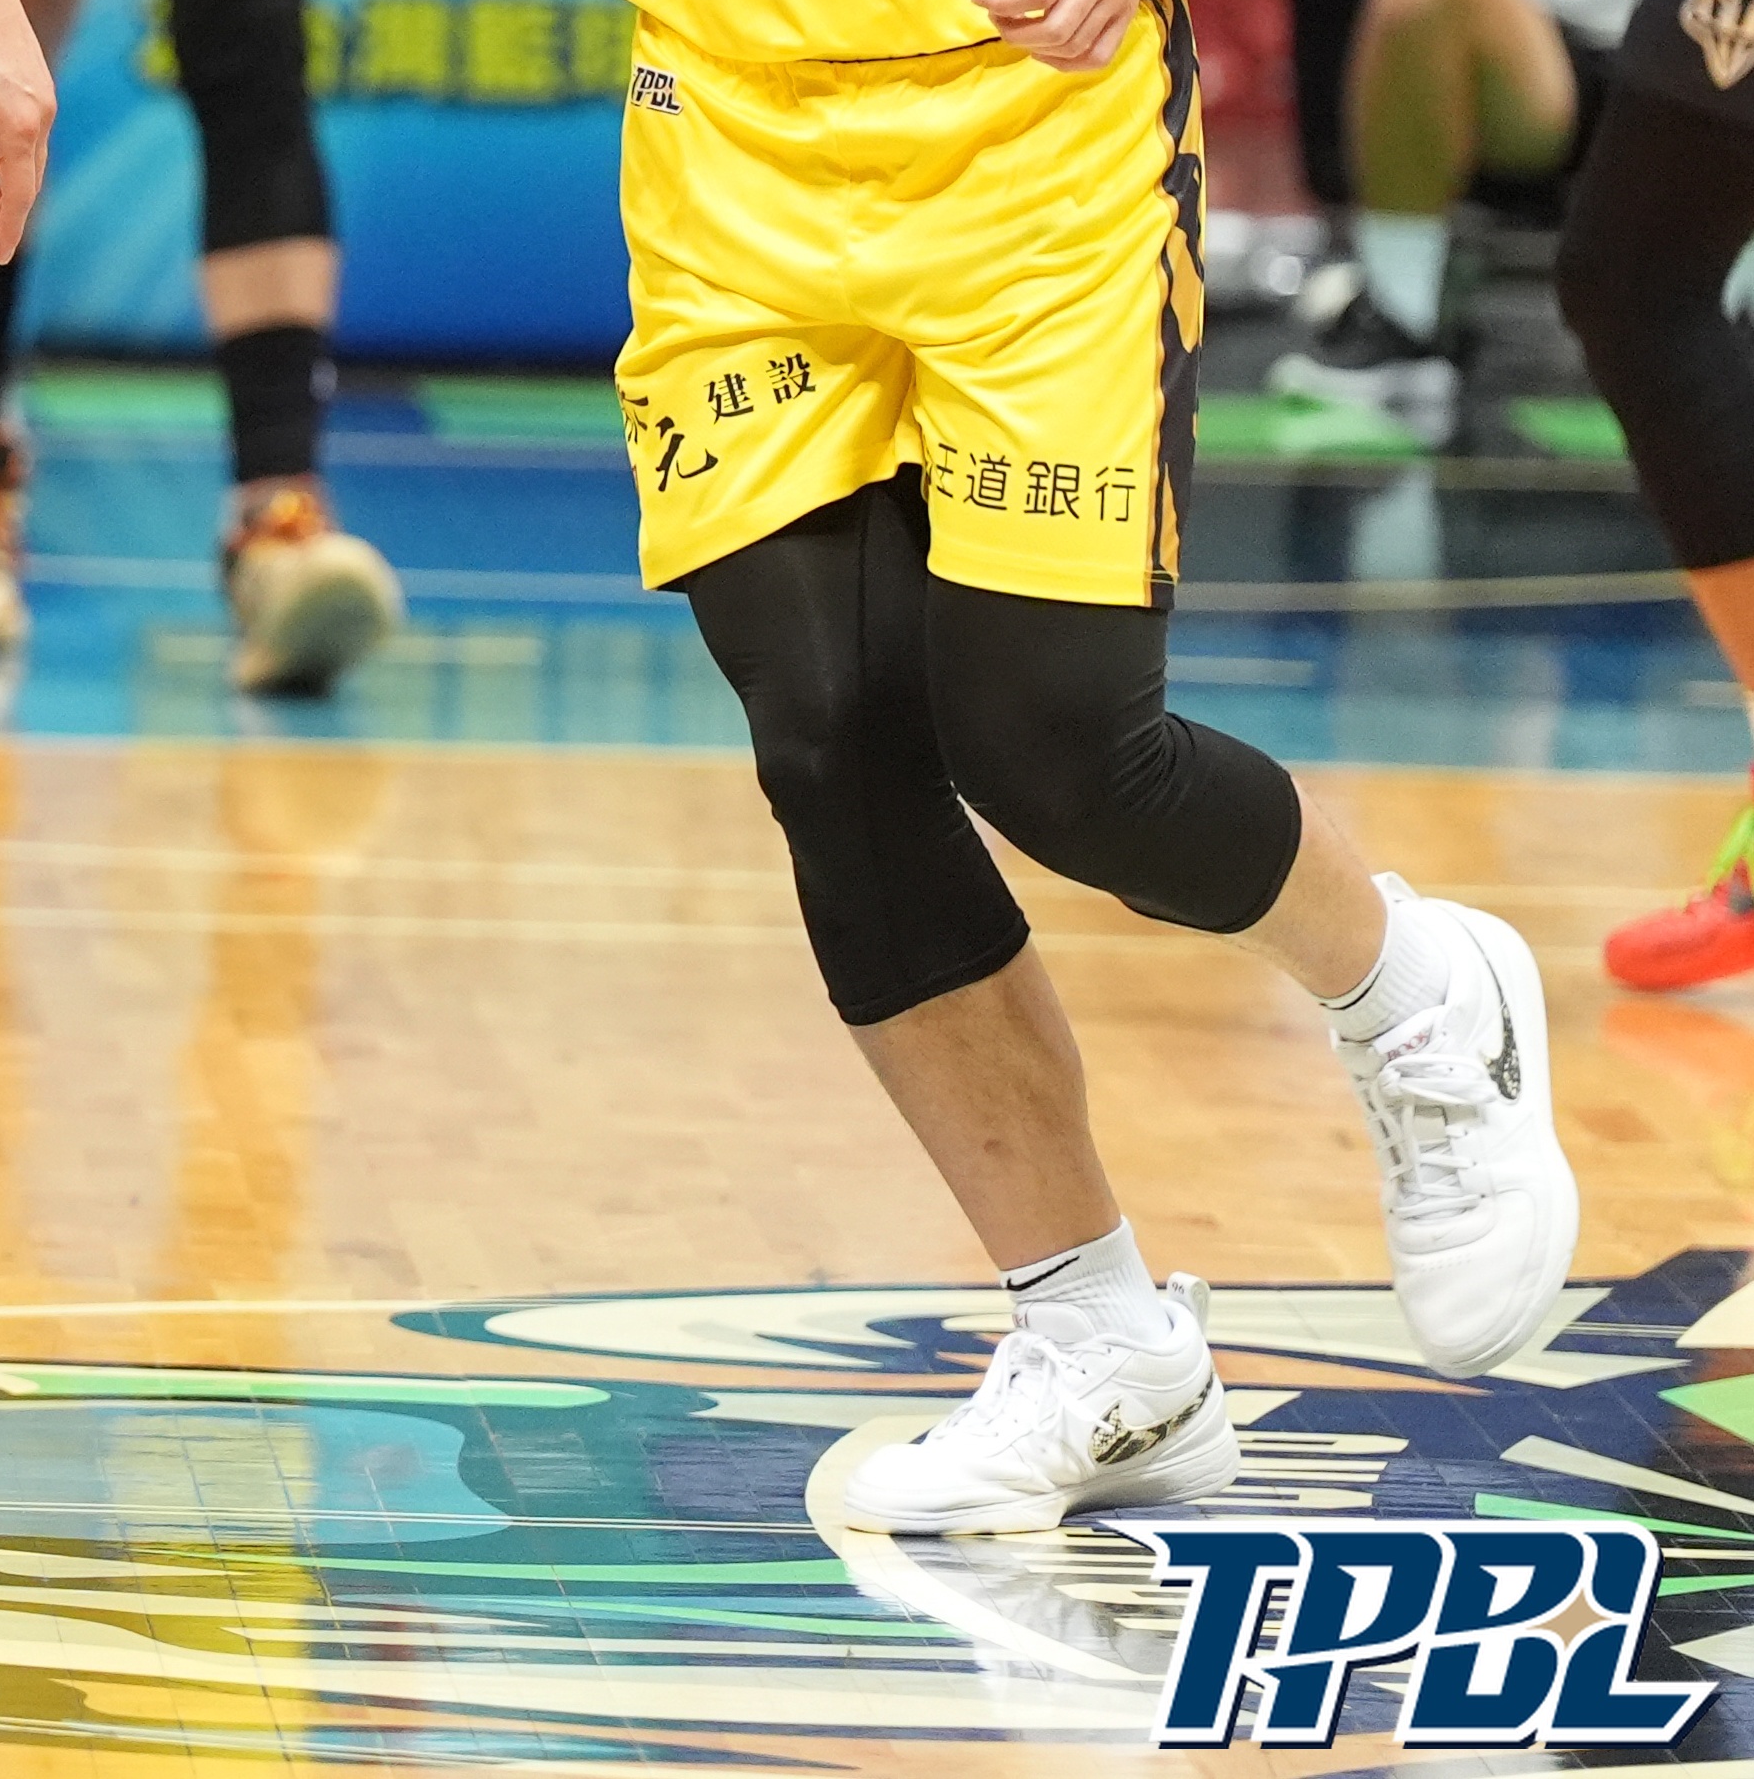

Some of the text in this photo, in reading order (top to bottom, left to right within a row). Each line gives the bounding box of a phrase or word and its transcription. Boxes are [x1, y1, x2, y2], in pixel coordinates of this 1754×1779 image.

[631, 65, 684, 115] TPBL
[703, 353, 817, 425] 建設
[935, 443, 1137, 522] 王道銀行
